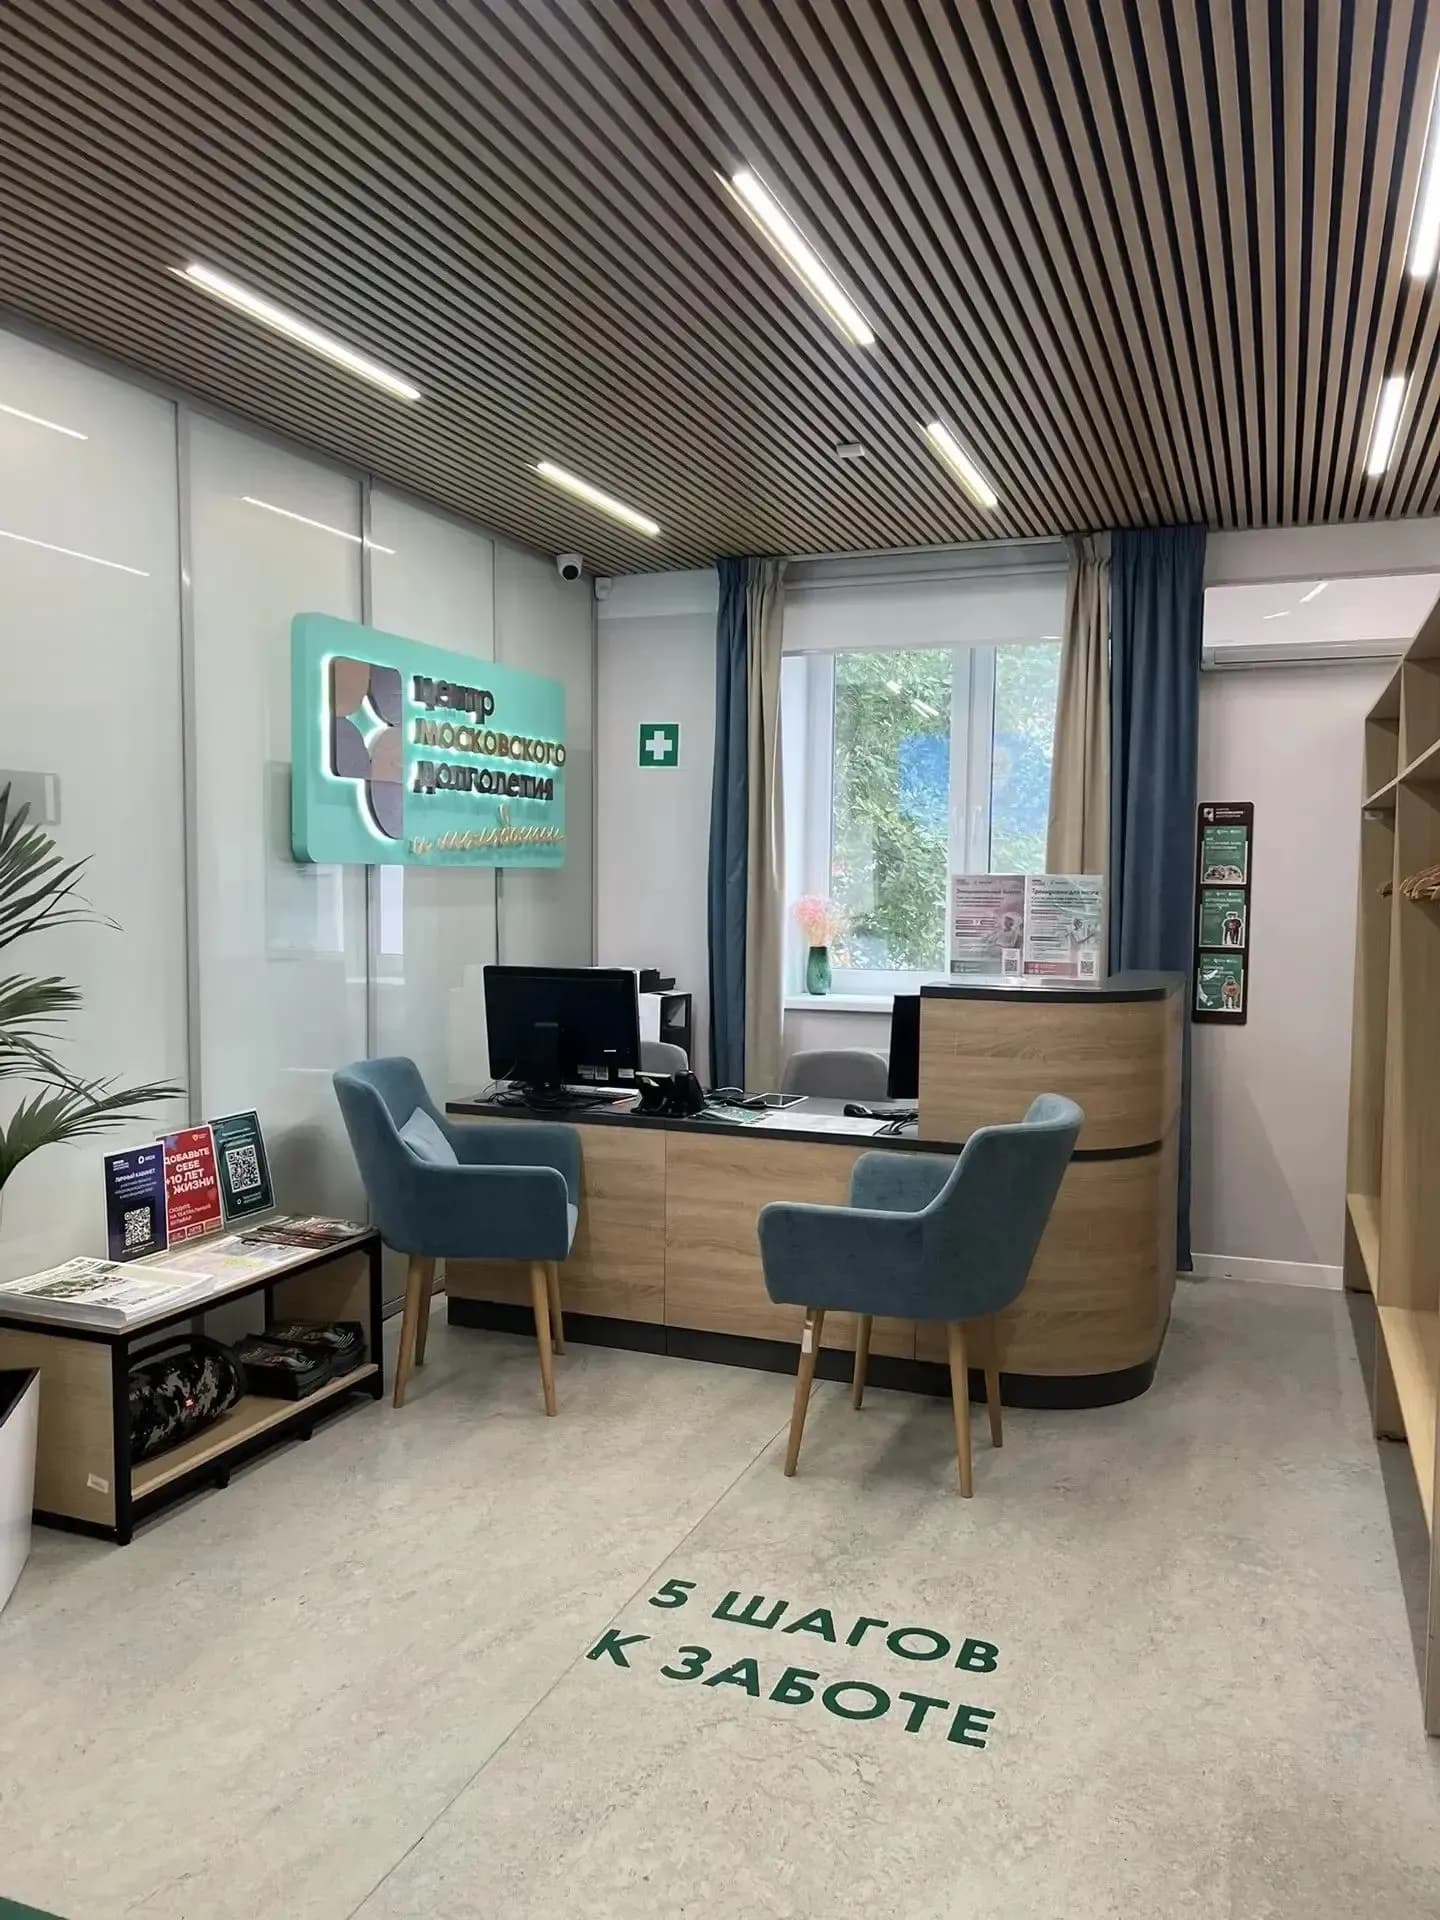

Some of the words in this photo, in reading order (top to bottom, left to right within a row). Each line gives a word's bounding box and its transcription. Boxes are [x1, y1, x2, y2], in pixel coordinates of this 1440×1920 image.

[413, 675, 495, 725] центр
[413, 717, 566, 767] московского
[413, 760, 554, 801] долголетия
[164, 1147, 210, 1165] ДОБАВЬТЕ
[175, 1159, 201, 1172] СЕБЕ
[183, 1168, 204, 1182] ЛЕТ
[172, 1175, 214, 1195] ЖИЗНИ
[648, 1578, 698, 1609] 5
[711, 1590, 1001, 1674] ШАГОВ
[585, 1628, 652, 1669] К
[659, 1645, 997, 1750] ЗАБОТЕ
